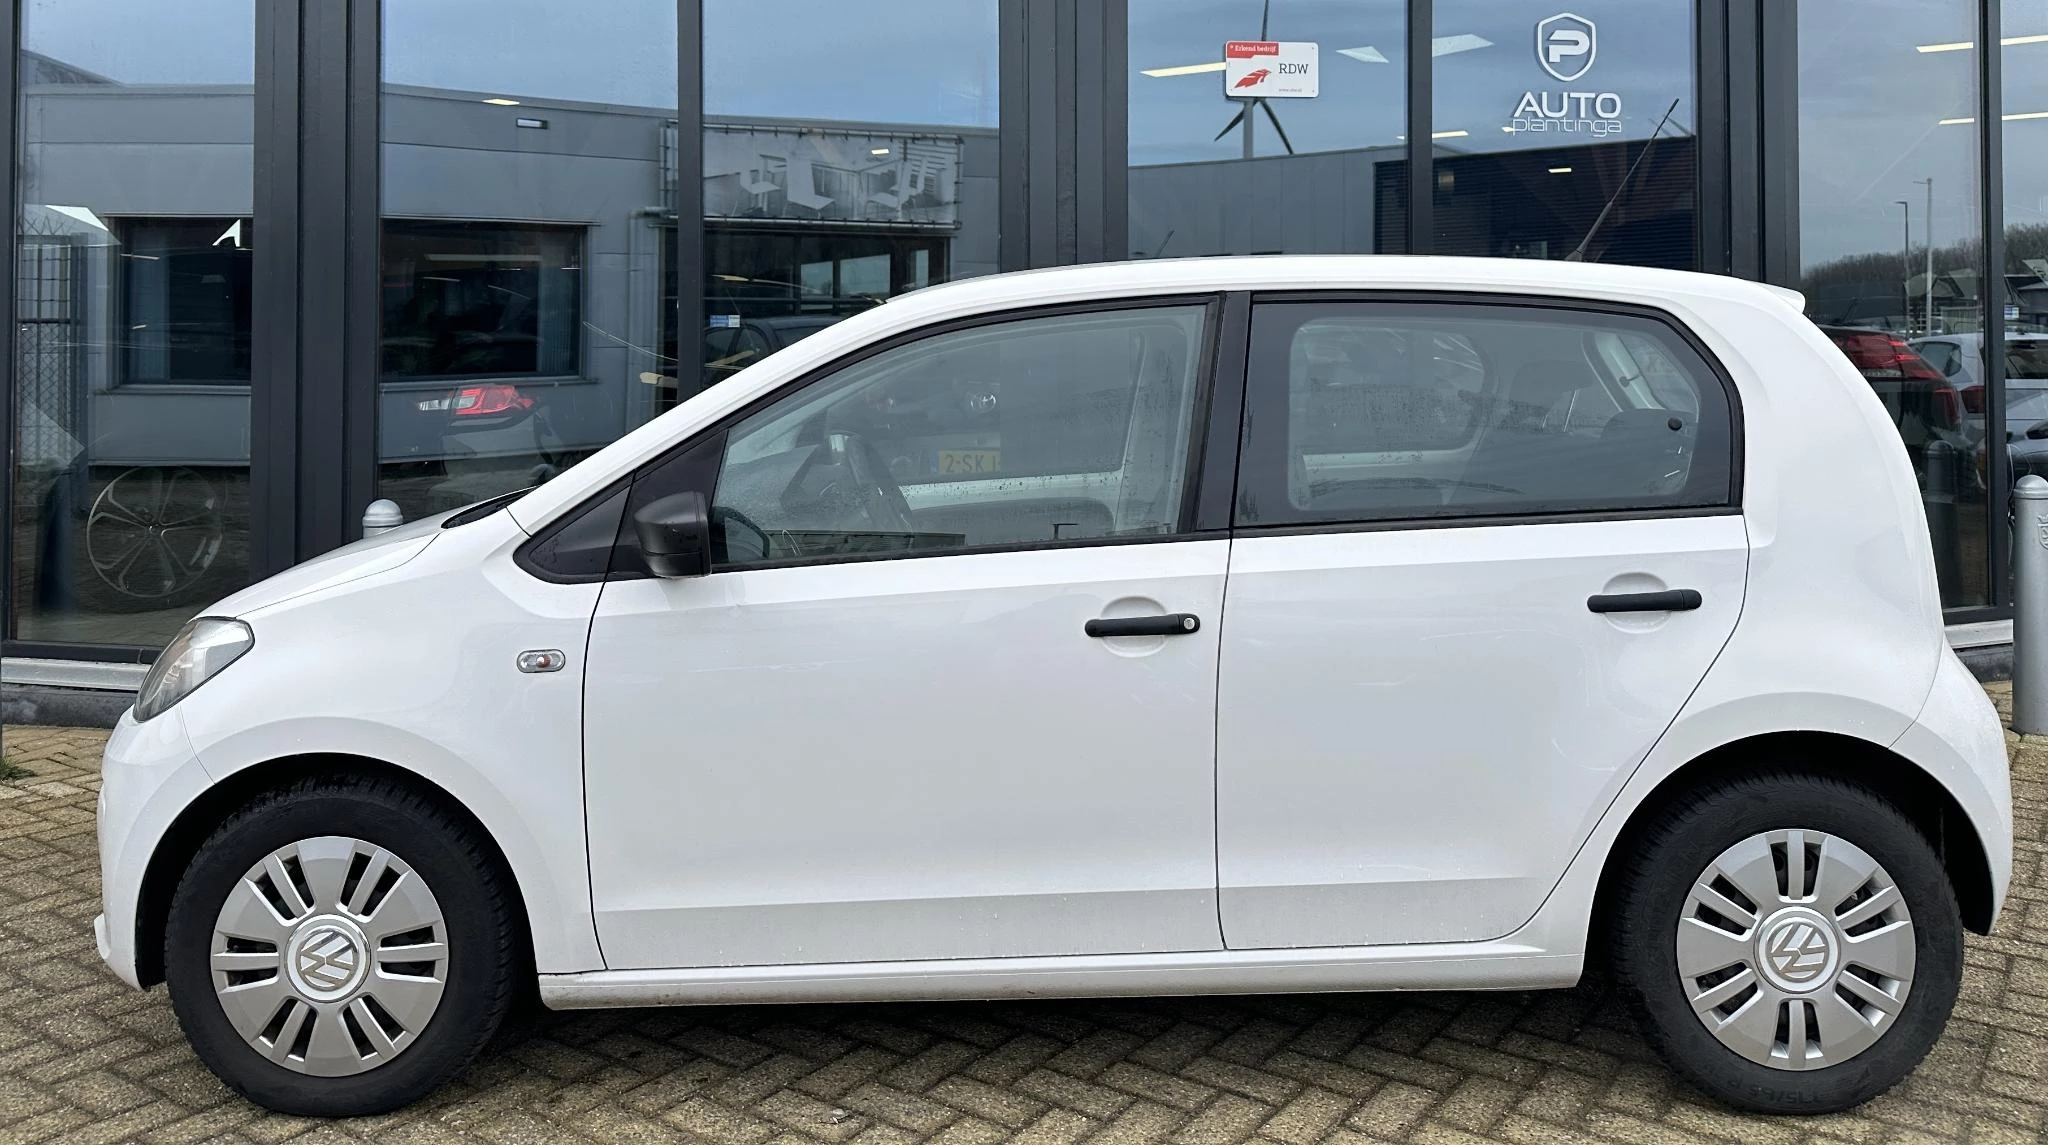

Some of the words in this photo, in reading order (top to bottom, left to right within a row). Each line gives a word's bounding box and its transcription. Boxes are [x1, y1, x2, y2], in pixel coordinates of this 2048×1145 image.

[1548, 29, 1590, 63] P
[1278, 63, 1309, 75] RDW
[1513, 91, 1622, 119] AUTO
[1512, 116, 1622, 138] plantinga
